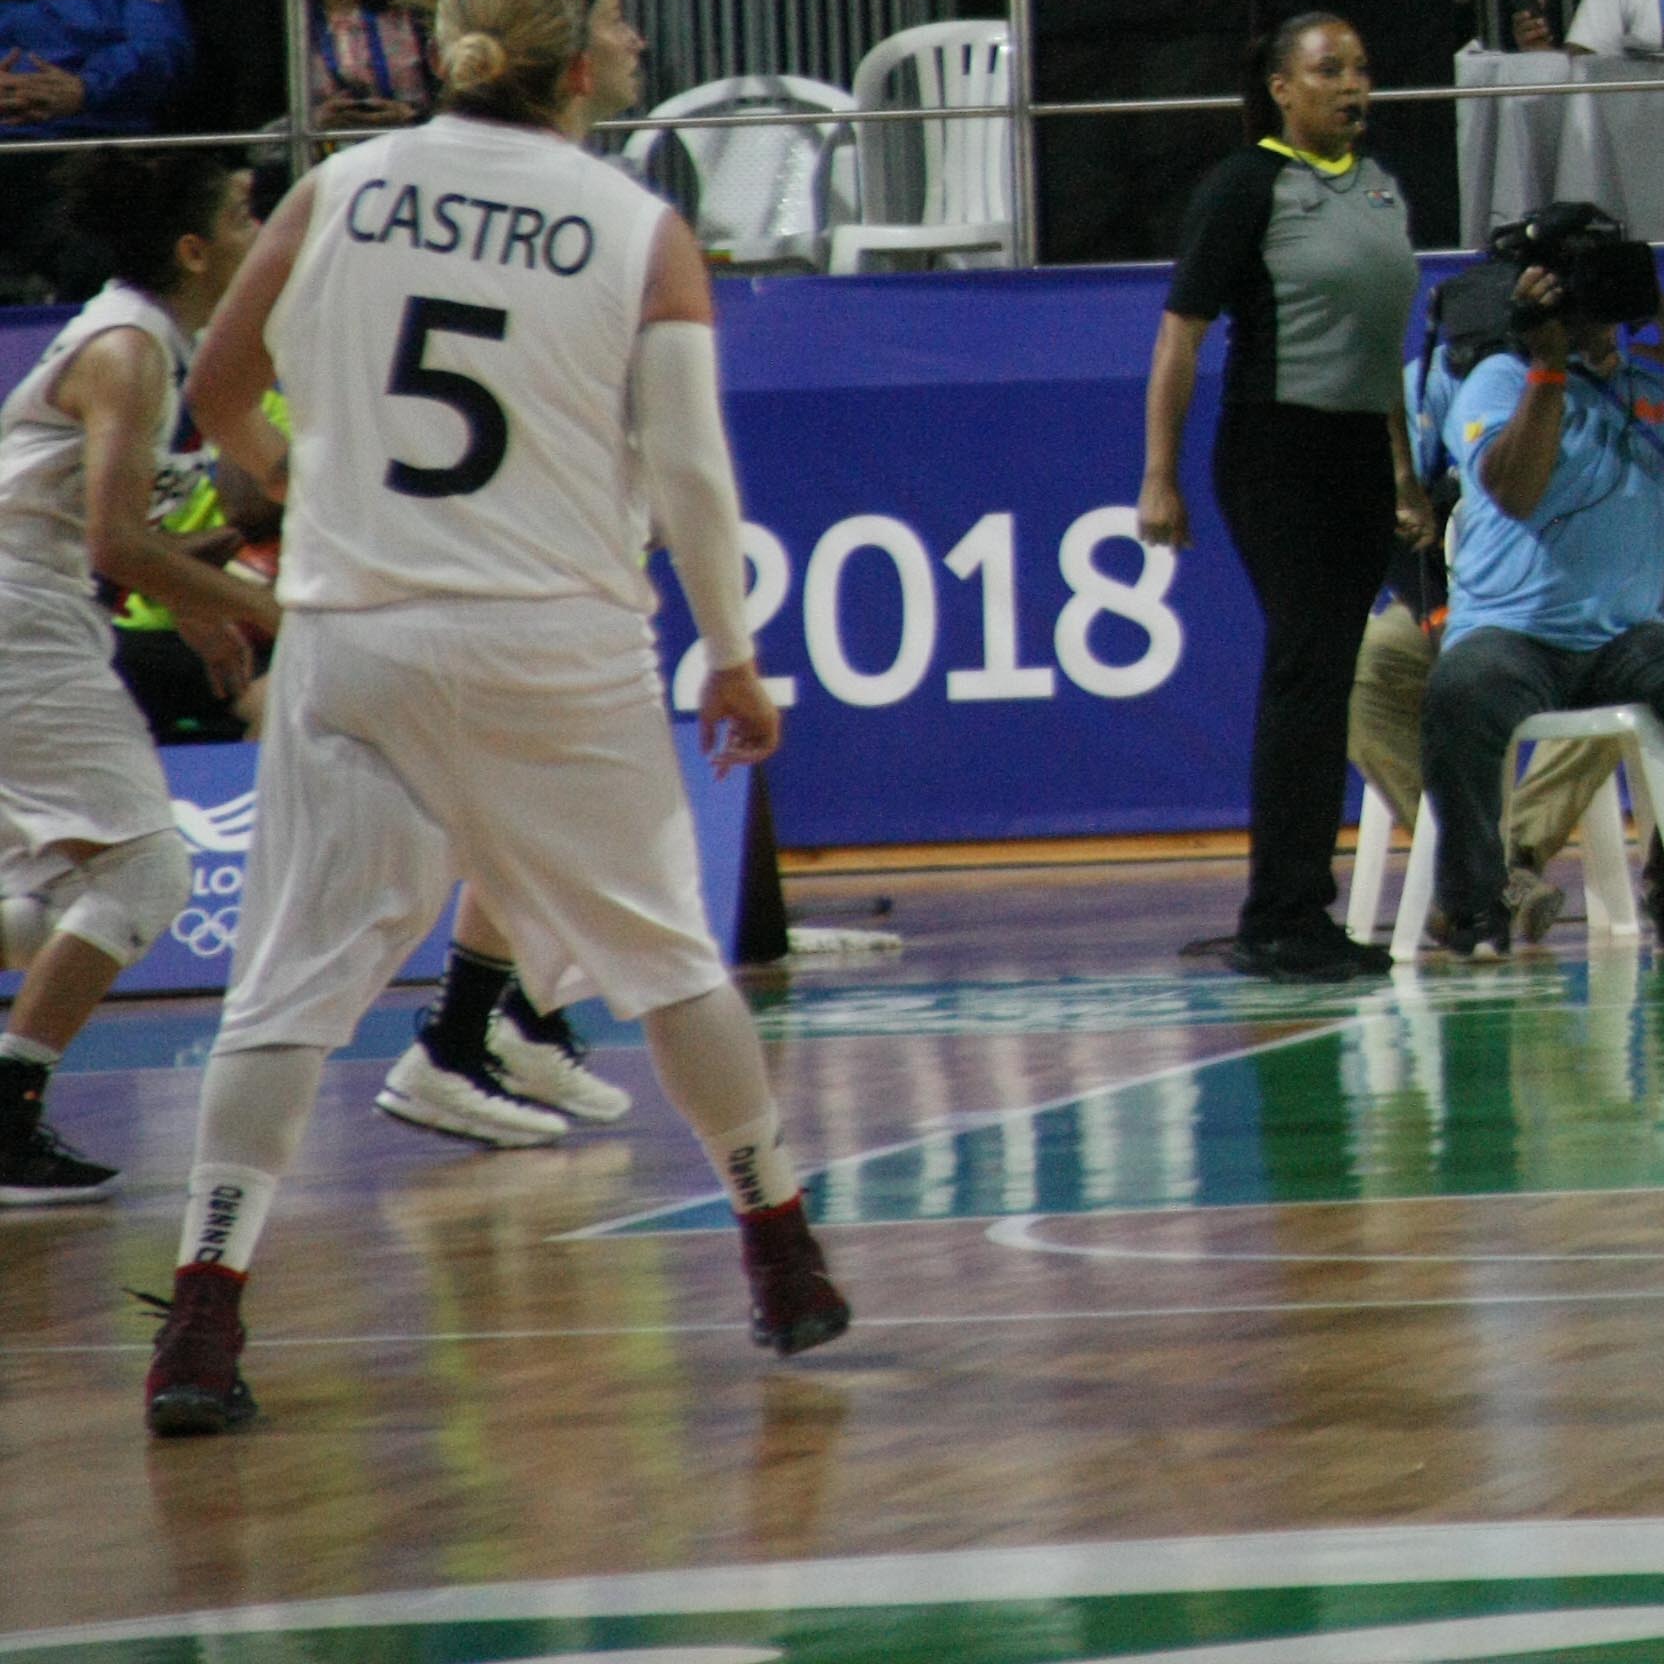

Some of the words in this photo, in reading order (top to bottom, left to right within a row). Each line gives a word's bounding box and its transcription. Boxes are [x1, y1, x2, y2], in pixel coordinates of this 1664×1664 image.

[348, 179, 595, 277] CASTRO
[385, 297, 508, 498] 5
[673, 504, 1185, 712] 2018
